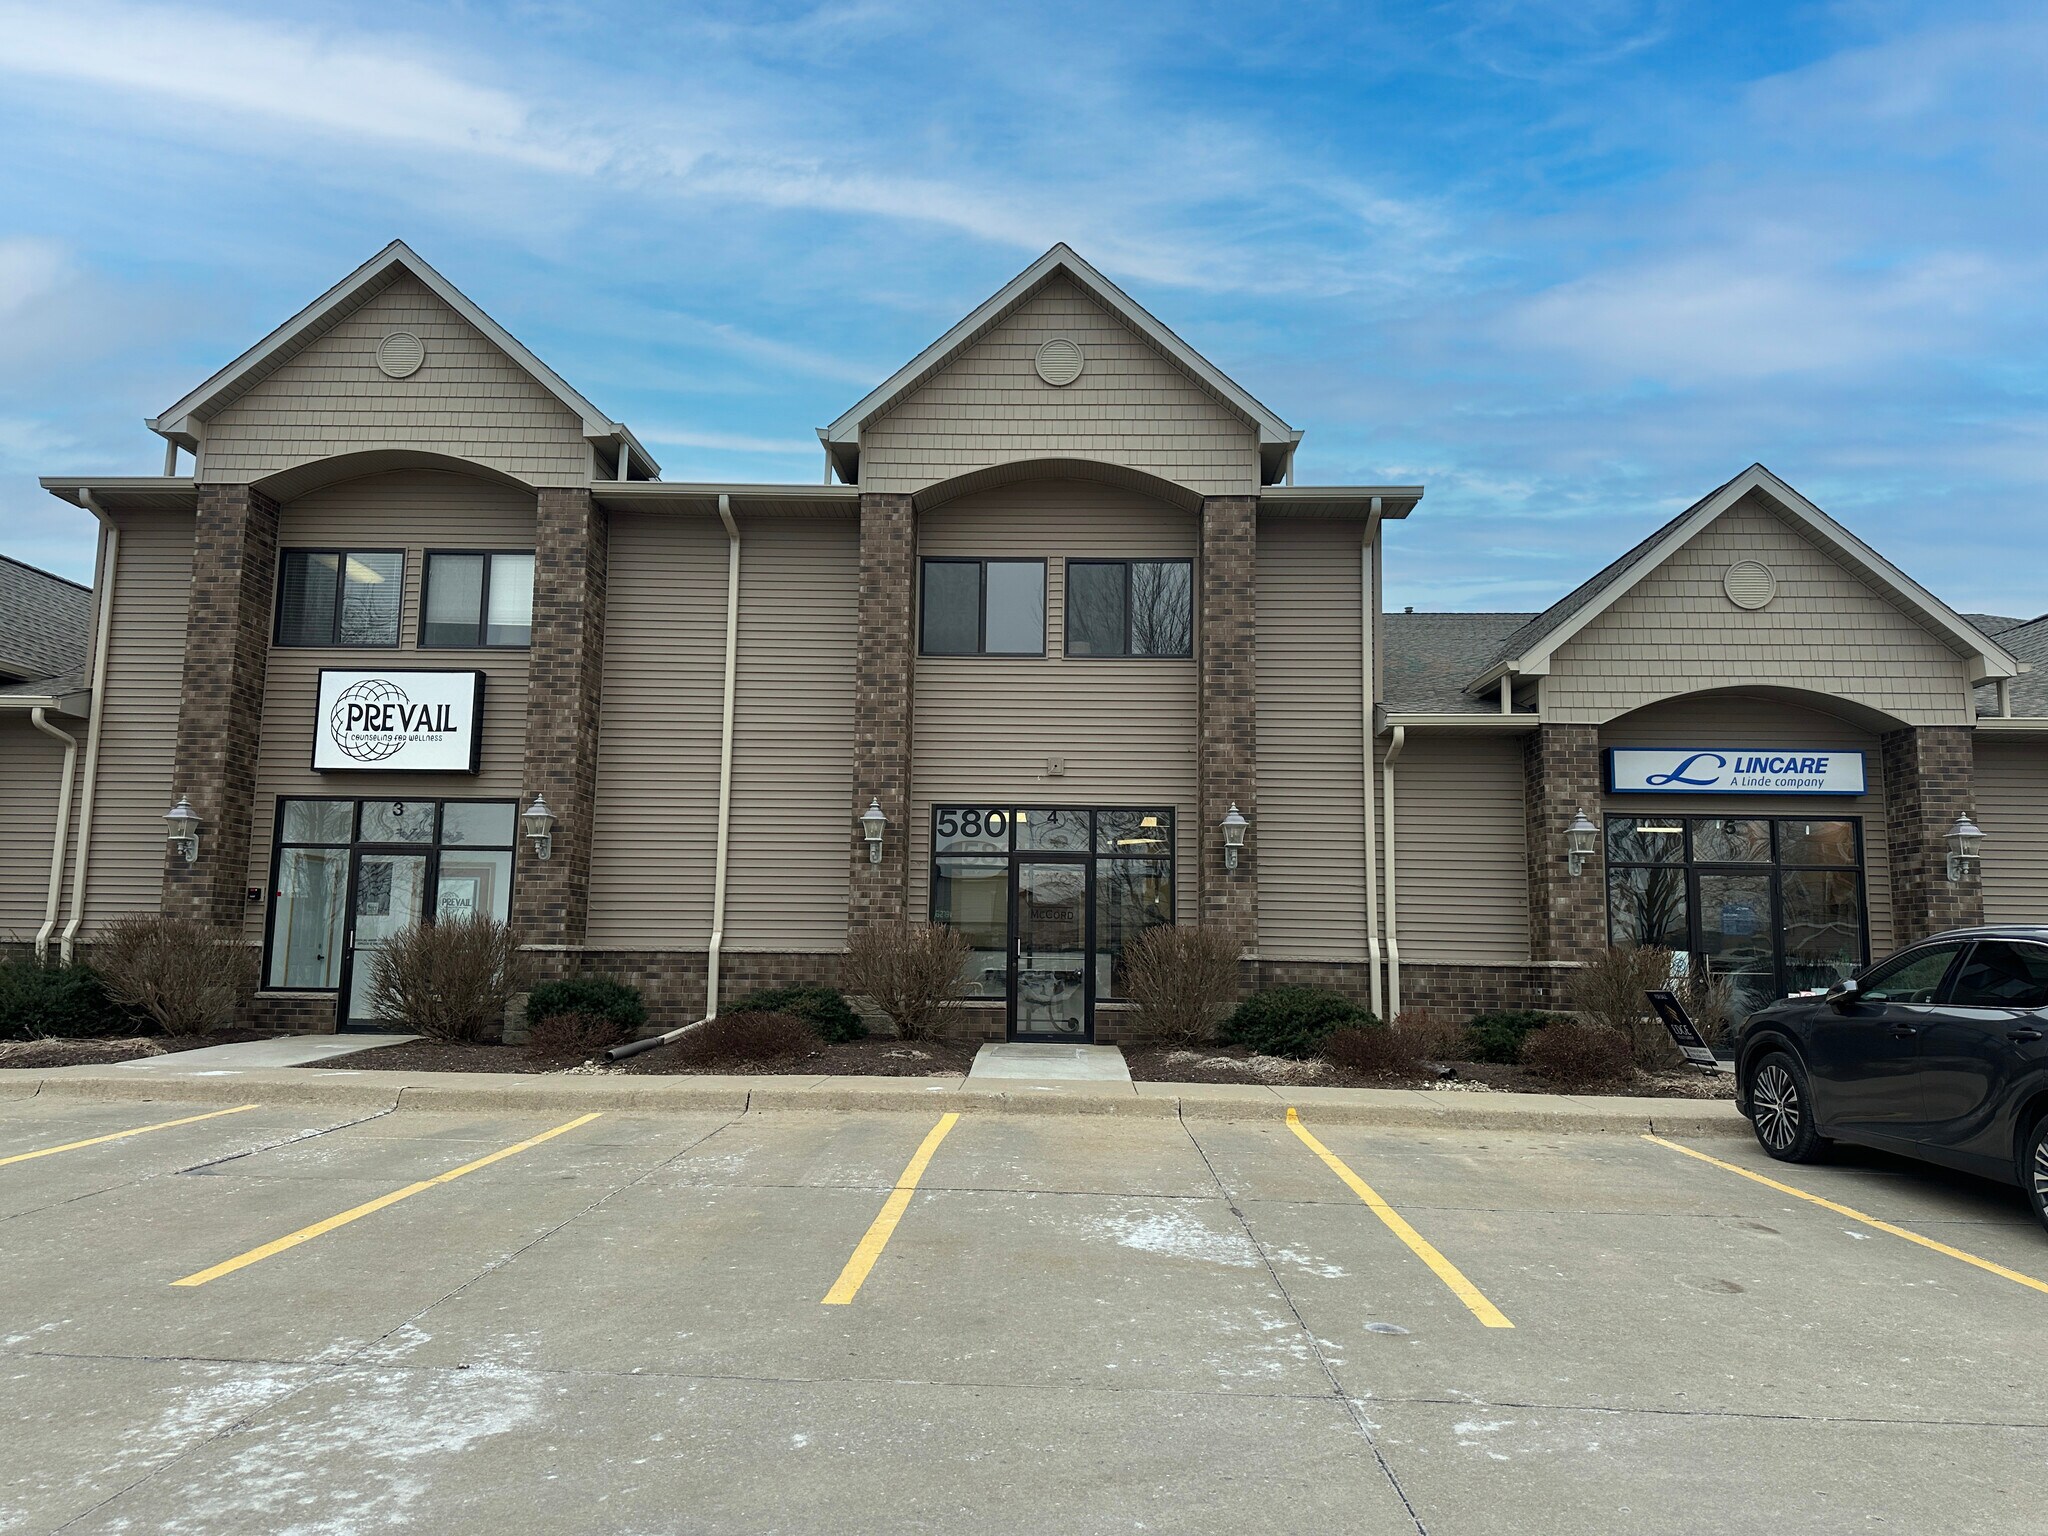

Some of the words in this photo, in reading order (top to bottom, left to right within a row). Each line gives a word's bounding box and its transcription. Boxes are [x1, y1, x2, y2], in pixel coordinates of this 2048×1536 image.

[345, 703, 457, 733] PREVAIL
[1733, 756, 1830, 774] LINCARE
[1730, 776, 1738, 787] A
[1741, 775, 1771, 787] Linde
[1774, 777, 1825, 789] company
[393, 801, 404, 817] 3
[937, 810, 1007, 838] 580
[1047, 810, 1059, 824] 4
[1724, 820, 1737, 835] 5
[441, 897, 472, 907] PREVAIL
